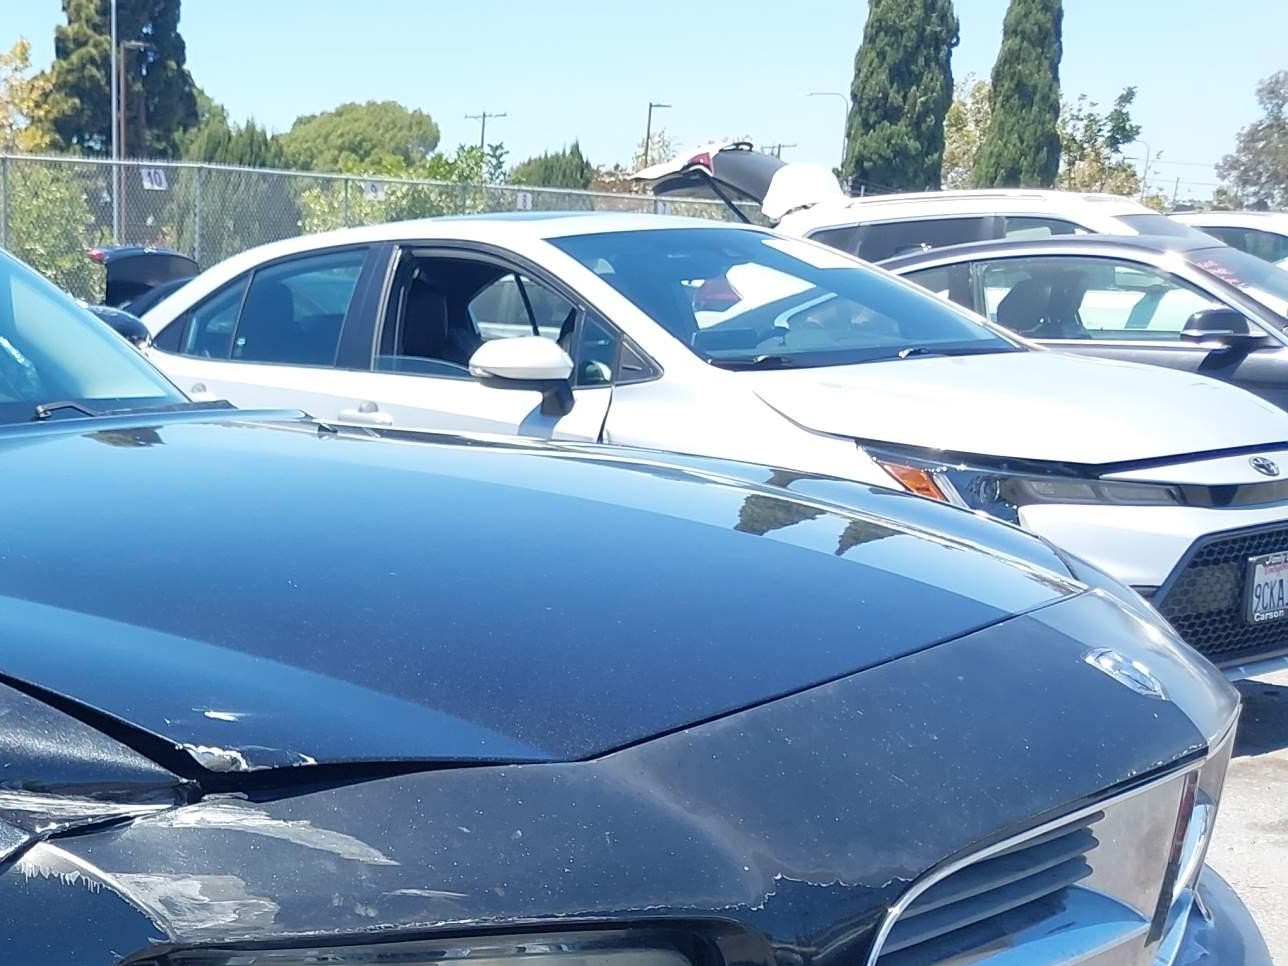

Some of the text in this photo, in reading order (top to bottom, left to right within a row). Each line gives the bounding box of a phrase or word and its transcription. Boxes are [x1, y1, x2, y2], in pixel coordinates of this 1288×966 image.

[147, 170, 163, 187] 10
[1254, 579, 1288, 612] 9CKA
[1254, 610, 1285, 621] Carson
